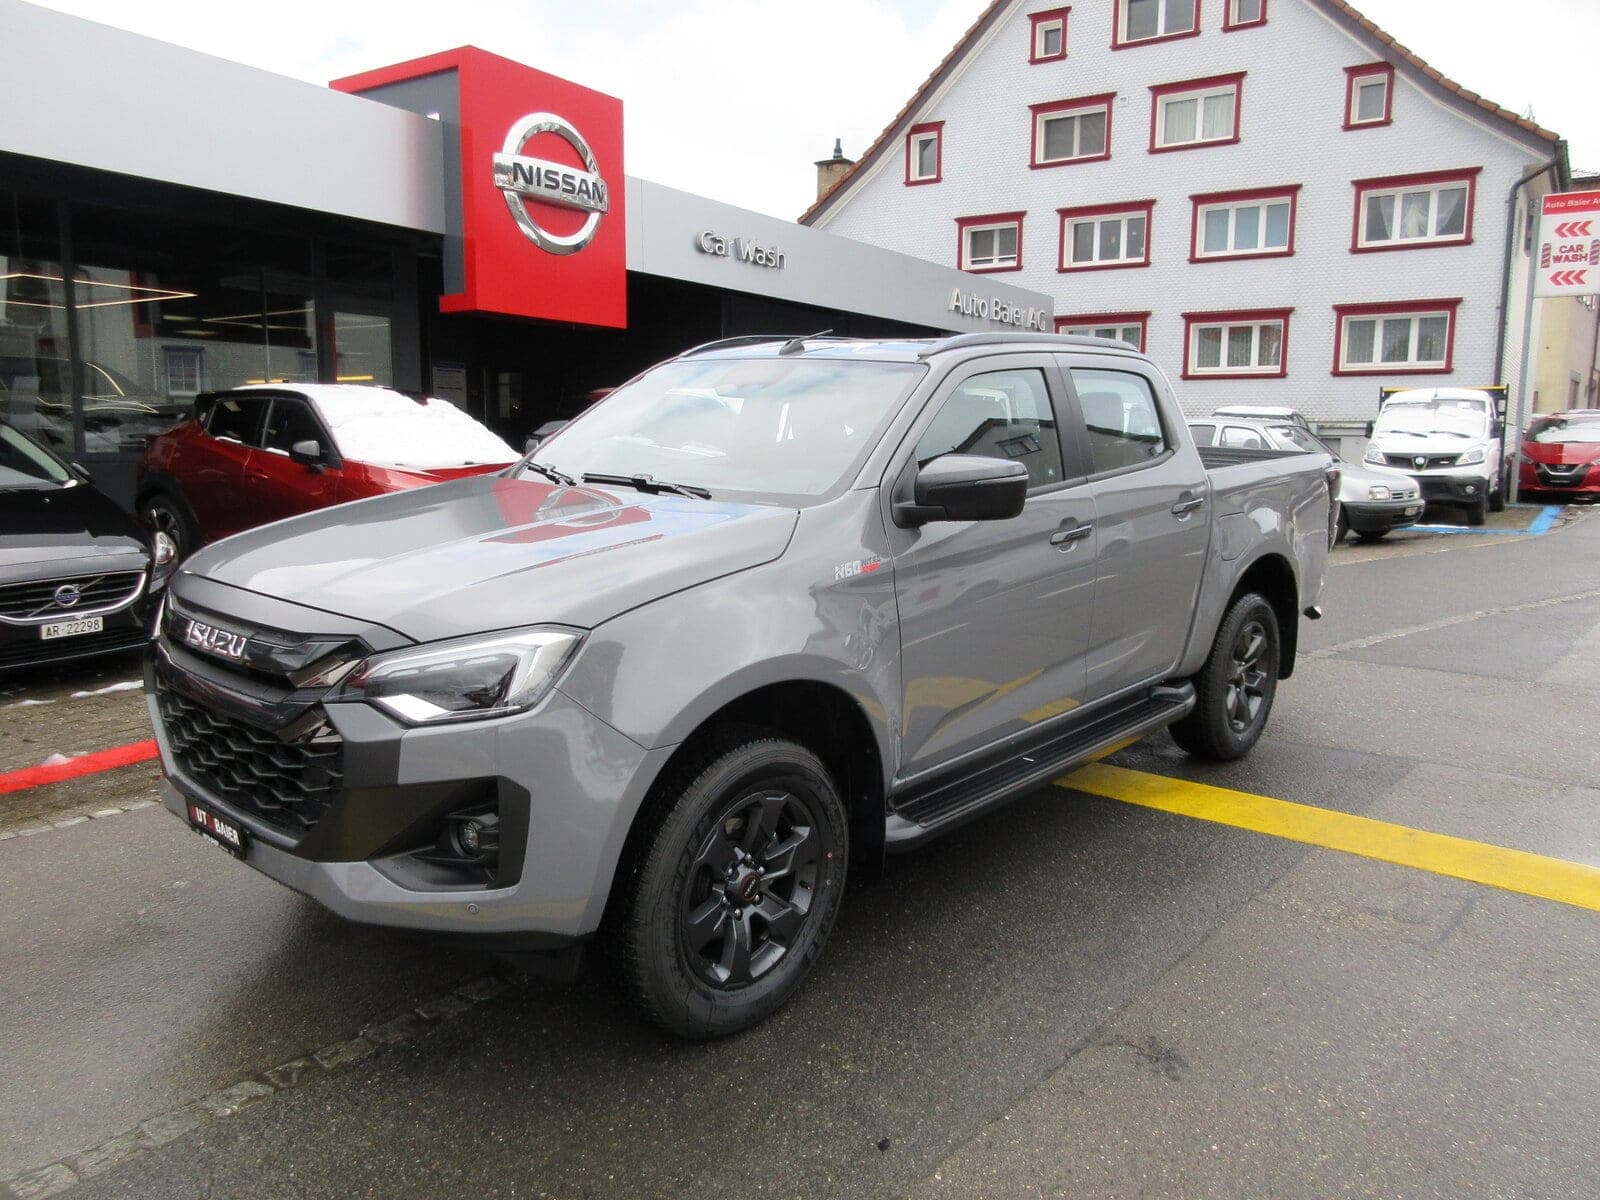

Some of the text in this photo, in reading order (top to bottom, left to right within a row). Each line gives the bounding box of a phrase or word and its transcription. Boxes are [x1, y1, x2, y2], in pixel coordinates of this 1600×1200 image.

[512, 161, 605, 204] NISSAN
[1545, 201, 1566, 209] Auto
[1567, 199, 1590, 208] Baier
[697, 230, 787, 270] Car Wash
[1552, 253, 1588, 264] WASH
[1559, 244, 1584, 254] CAR
[948, 287, 1047, 331] Auto Baier AG
[186, 620, 247, 660] ISUZU
